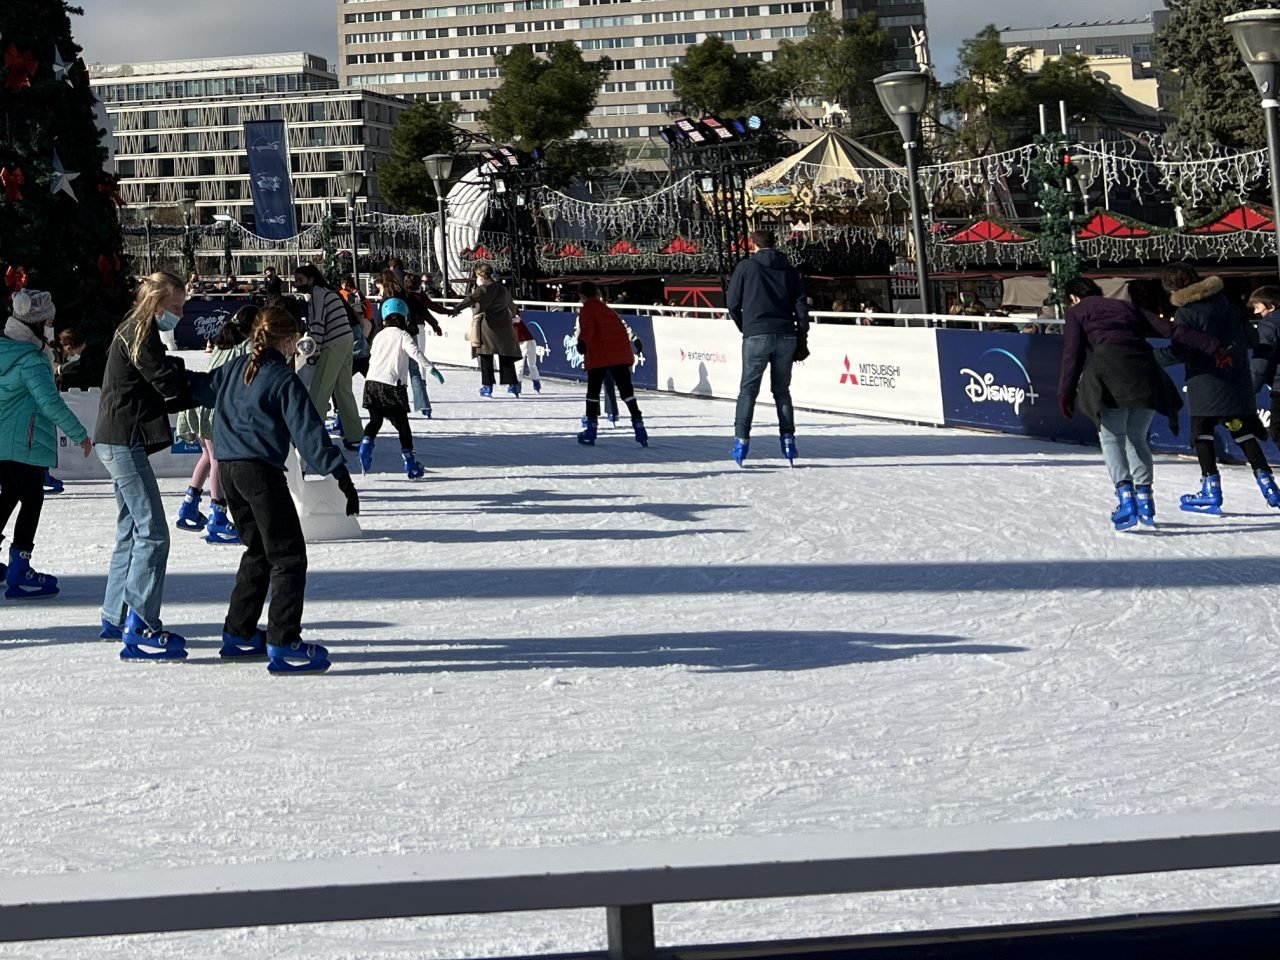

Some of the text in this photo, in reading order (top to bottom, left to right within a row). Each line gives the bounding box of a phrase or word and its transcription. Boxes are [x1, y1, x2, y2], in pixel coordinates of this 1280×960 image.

[858, 363, 902, 377] MITSUBISHI
[860, 375, 897, 389] ELECTRIC
[959, 367, 1040, 416] Disney+
